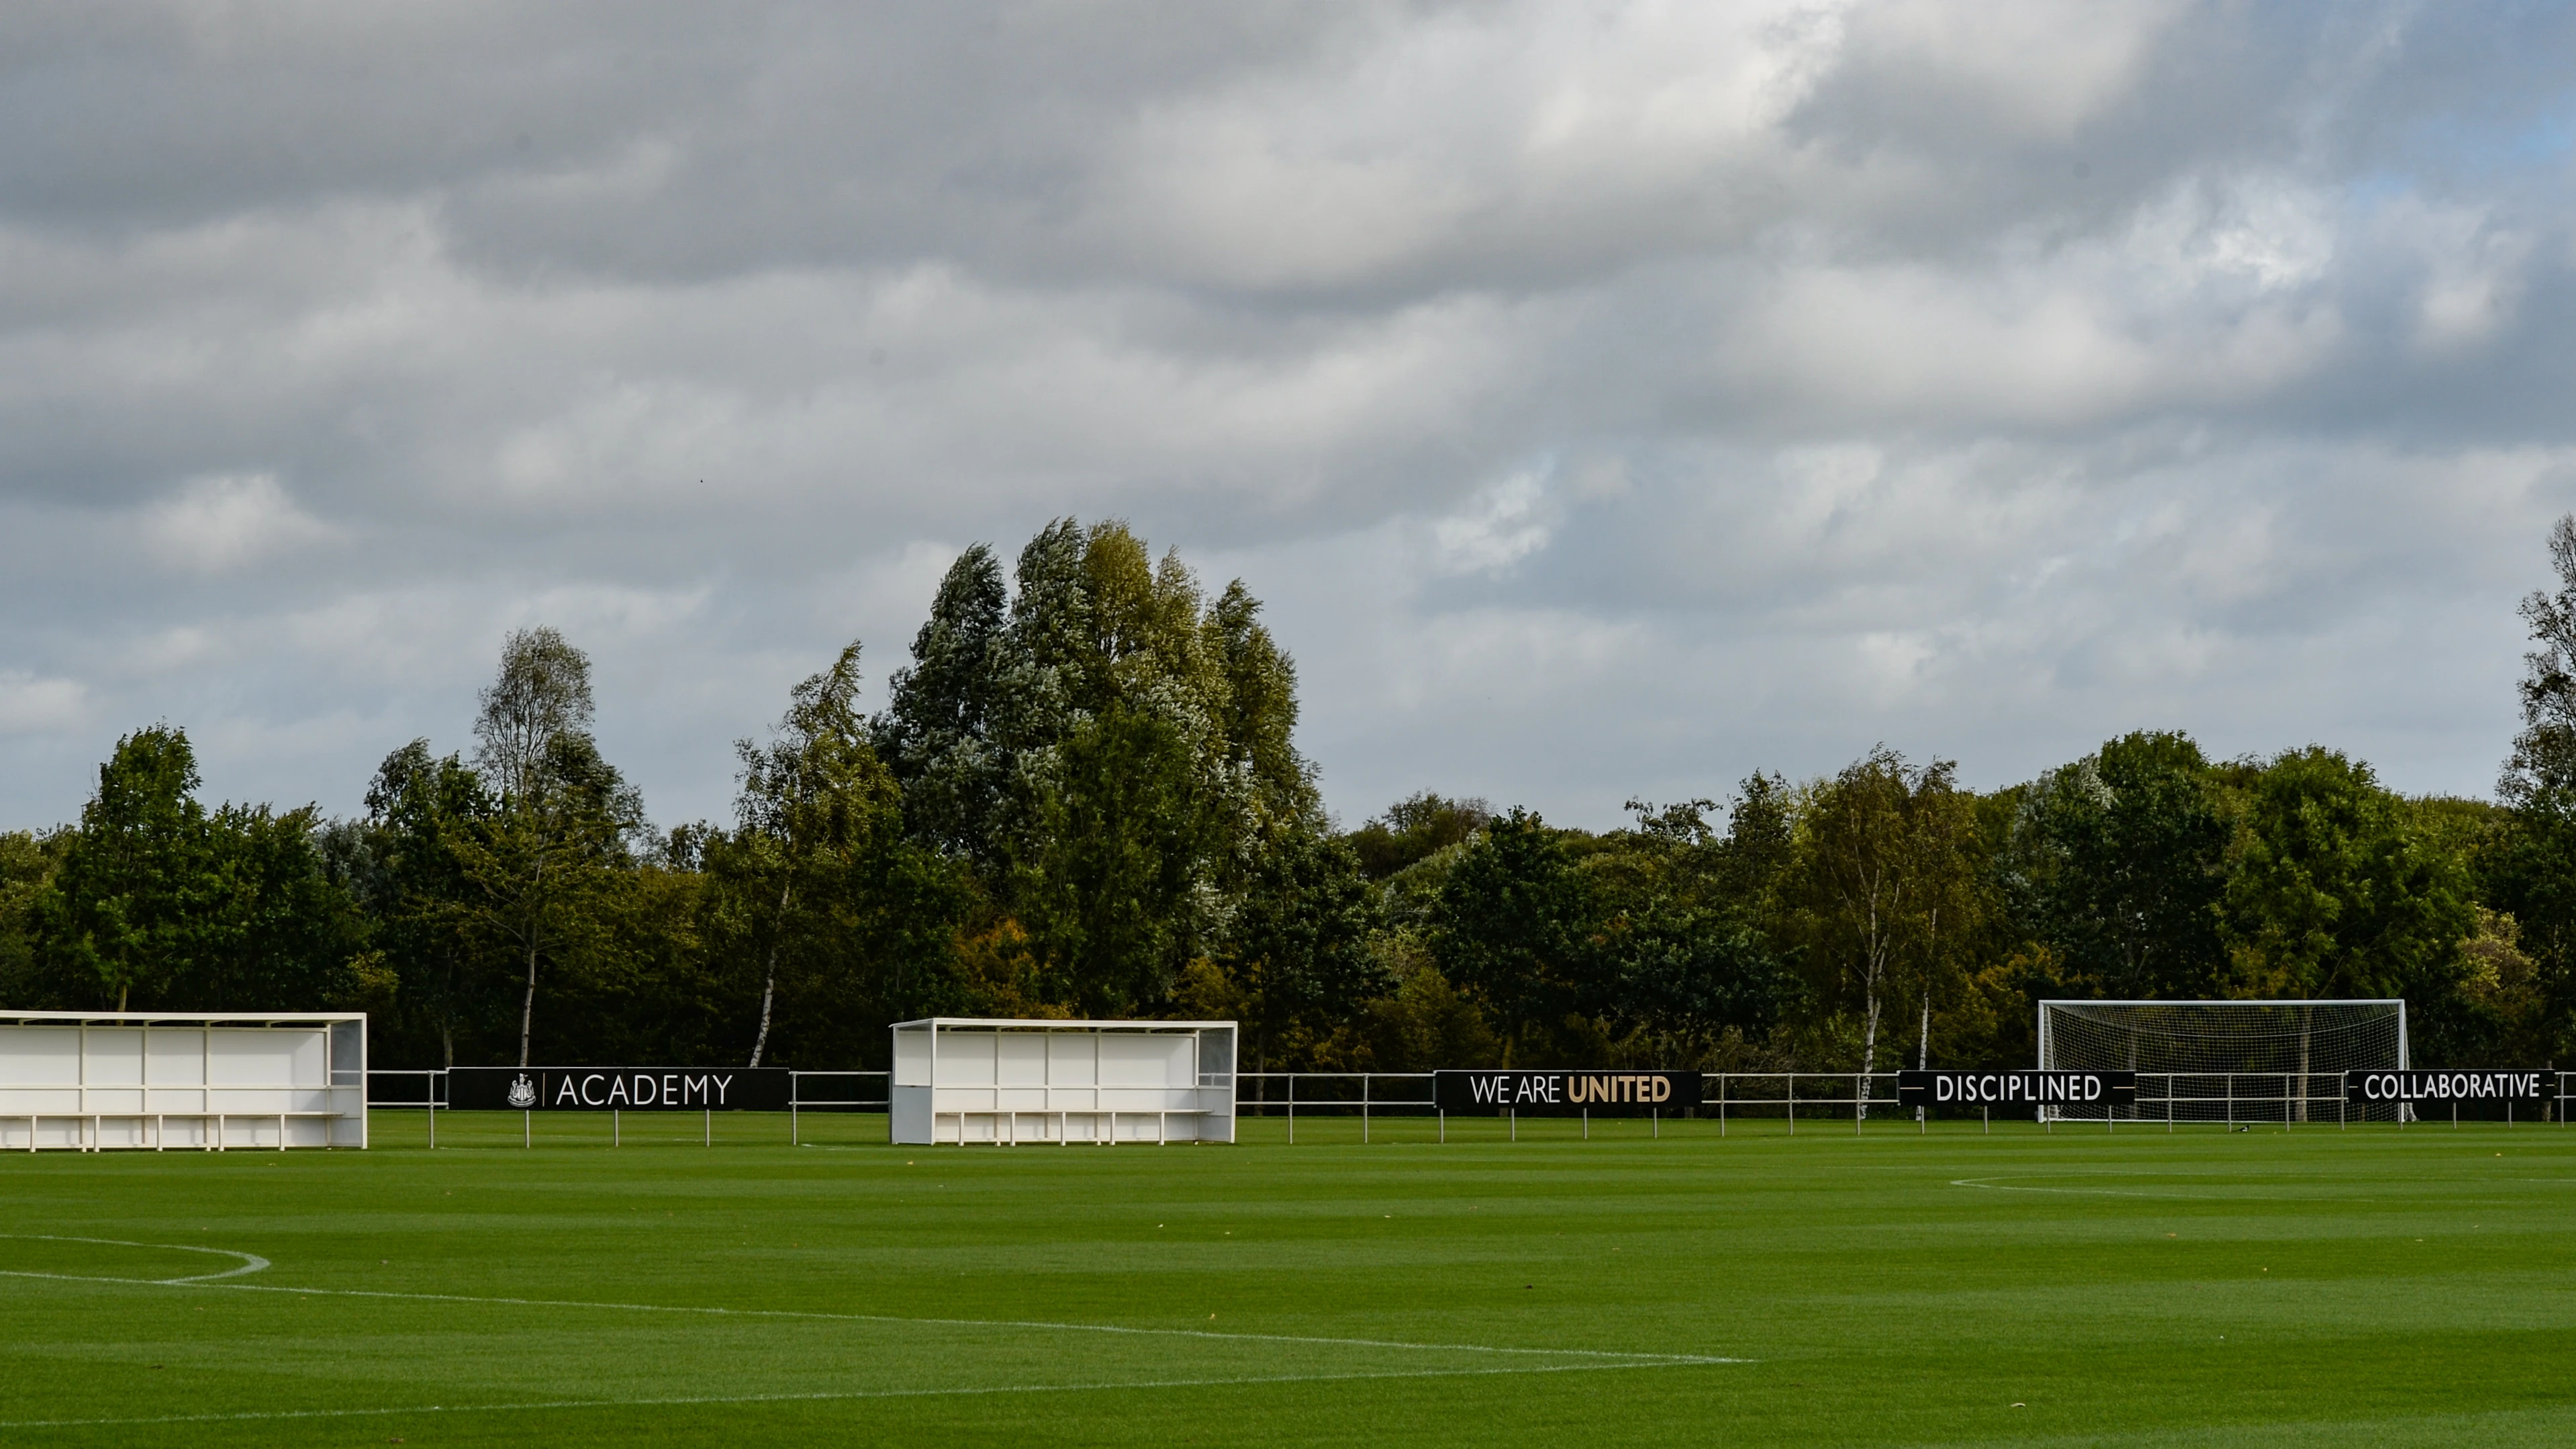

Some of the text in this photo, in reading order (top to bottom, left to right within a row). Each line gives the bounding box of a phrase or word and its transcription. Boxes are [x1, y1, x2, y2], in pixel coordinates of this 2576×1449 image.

[556, 1074, 732, 1105] ACADEMY
[1470, 1076, 1670, 1103] WE ARE UNITED
[1937, 1076, 2101, 1101] DISCIPLINED
[2365, 1074, 2539, 1099] COLLABORATIVE
